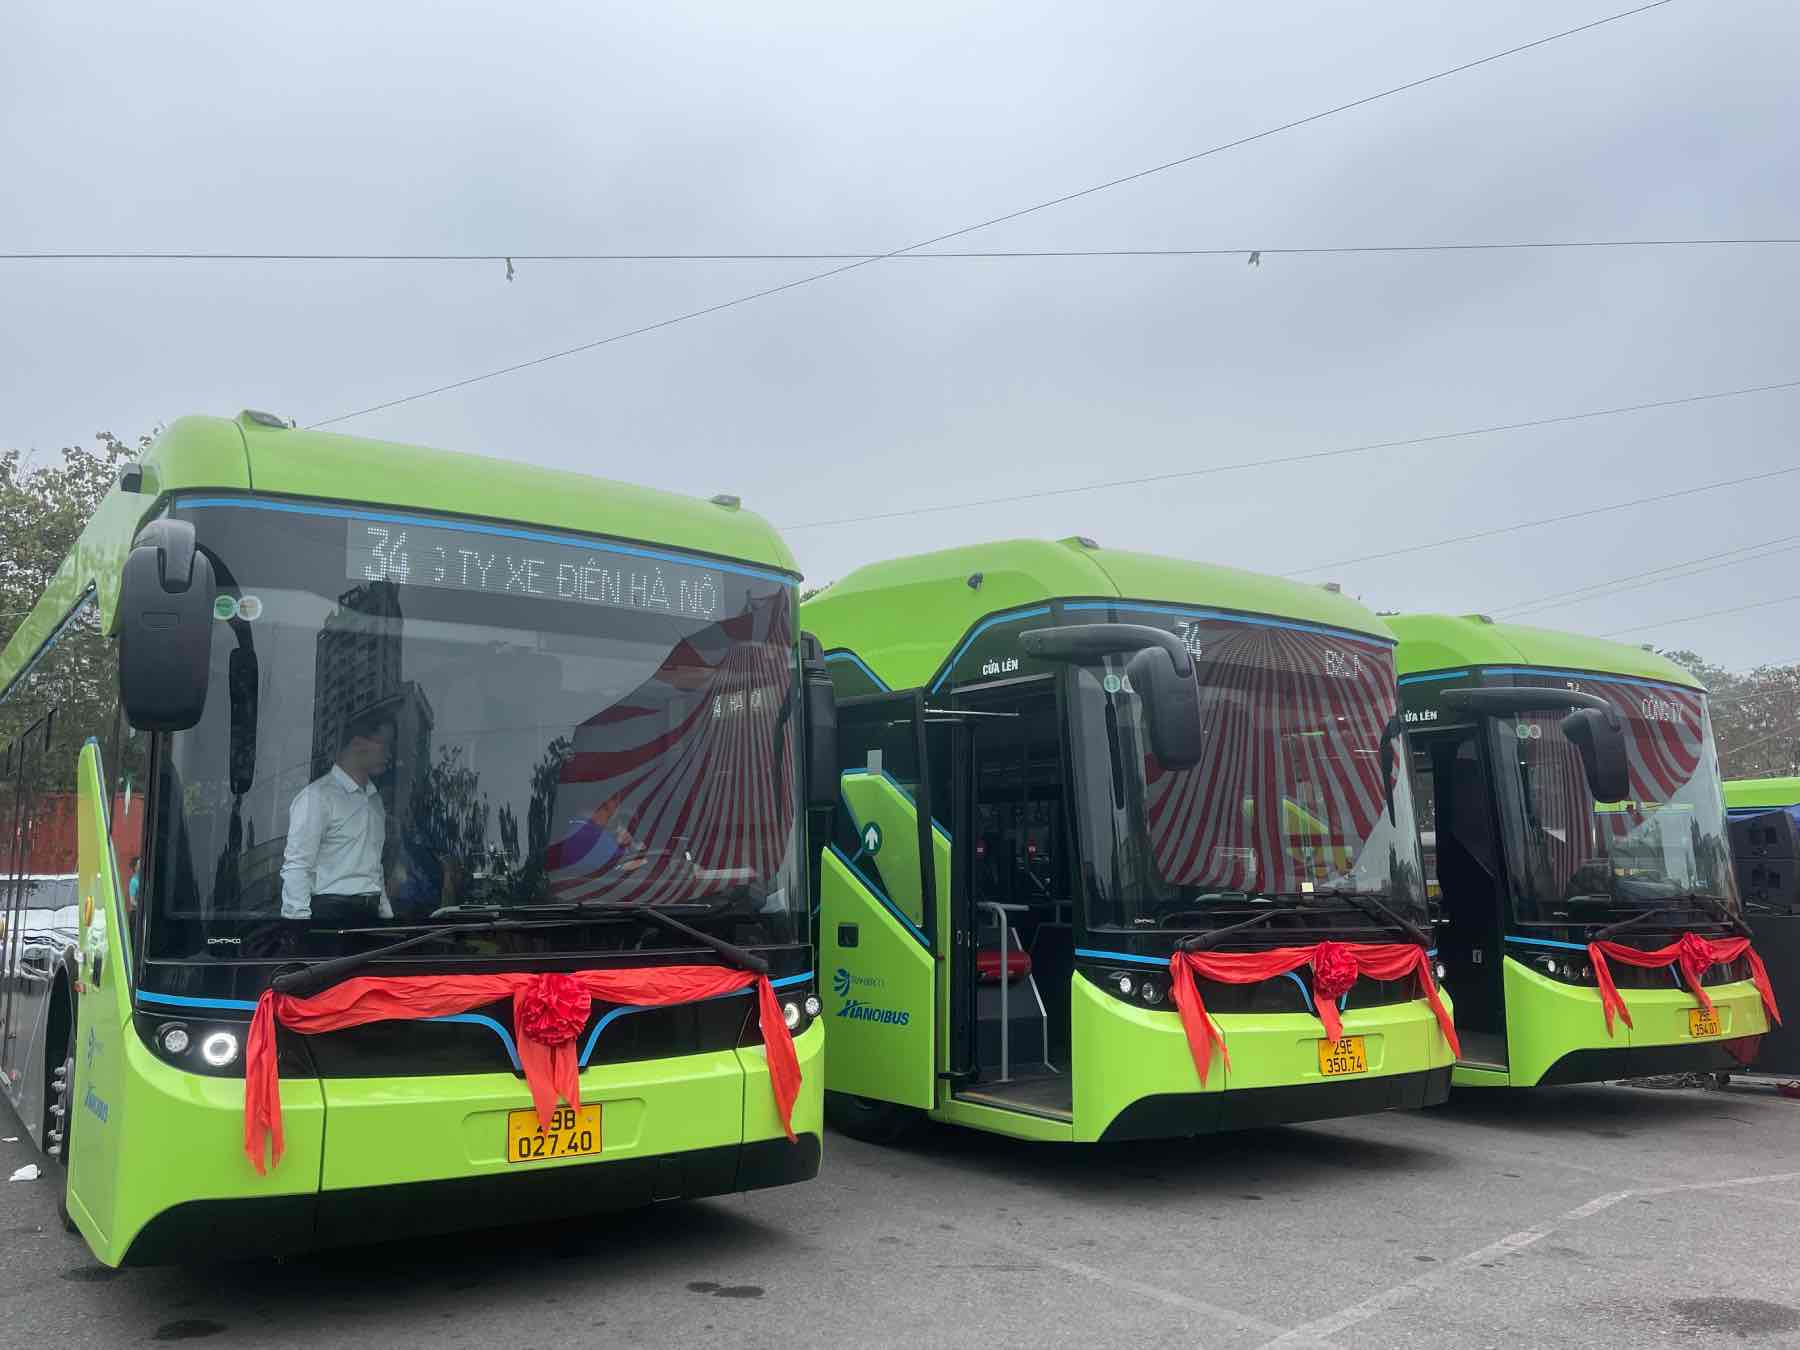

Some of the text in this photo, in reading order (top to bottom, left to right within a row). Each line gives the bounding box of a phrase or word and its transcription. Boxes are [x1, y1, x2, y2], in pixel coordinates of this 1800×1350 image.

[363, 527, 409, 585] 34
[459, 548, 496, 592] TY
[505, 556, 545, 593] XE
[632, 567, 670, 608] HÀ
[982, 657, 1019, 676] CỬA LÊN
[1404, 709, 1438, 722] ỬA LÊN
[1326, 1055, 1363, 1073] 350.74
[536, 1109, 576, 1133] 9B
[518, 1131, 593, 1158] 027.40
